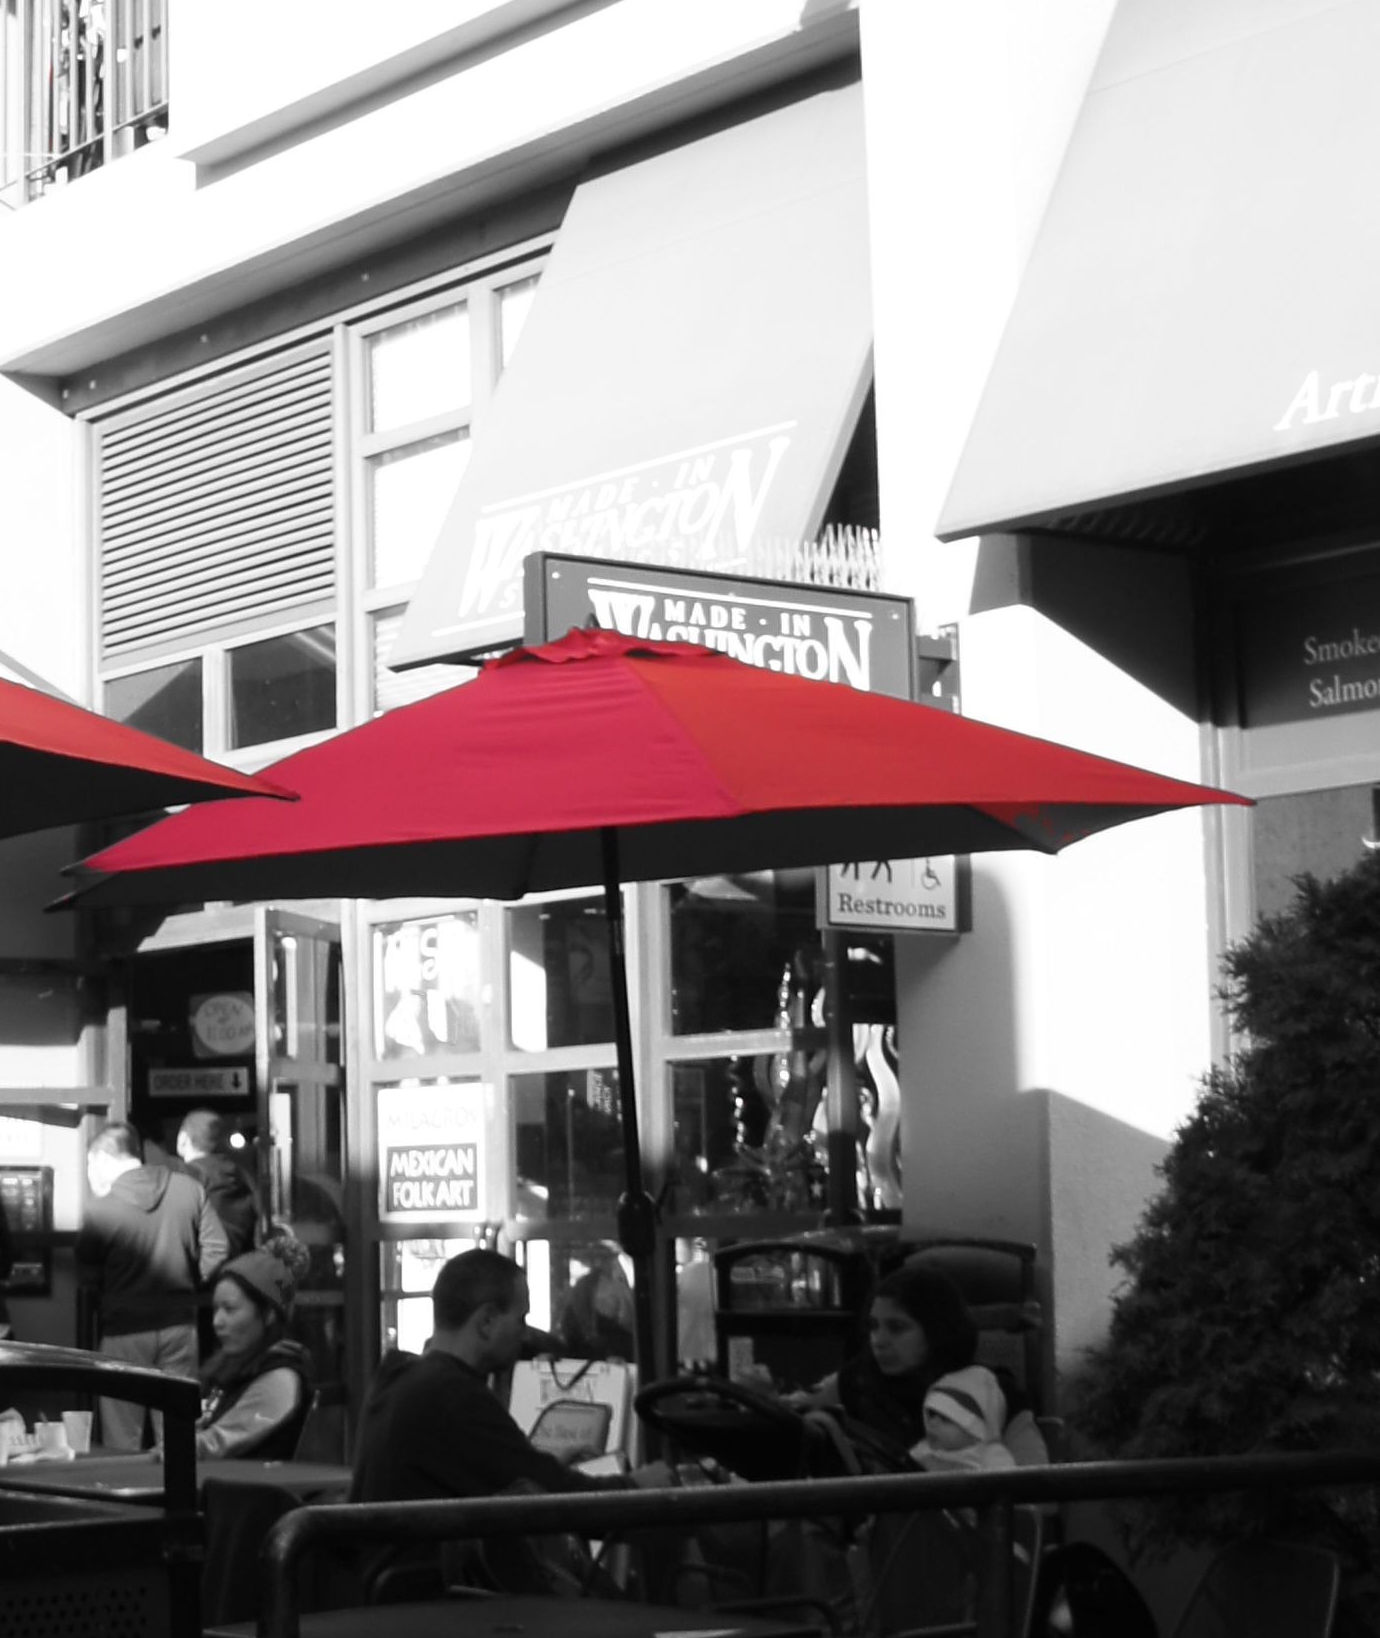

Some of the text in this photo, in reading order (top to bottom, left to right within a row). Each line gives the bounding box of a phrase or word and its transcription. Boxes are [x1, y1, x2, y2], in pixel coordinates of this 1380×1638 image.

[546, 453, 716, 524] MADE IN
[663, 598, 811, 637] MADE IN
[1303, 627, 1380, 666] Smoke
[1308, 674, 1380, 709] Salmo
[837, 892, 947, 919] Restrooms
[390, 1147, 474, 1178] MEXICAN
[393, 1179, 475, 1209] FOLK ART
